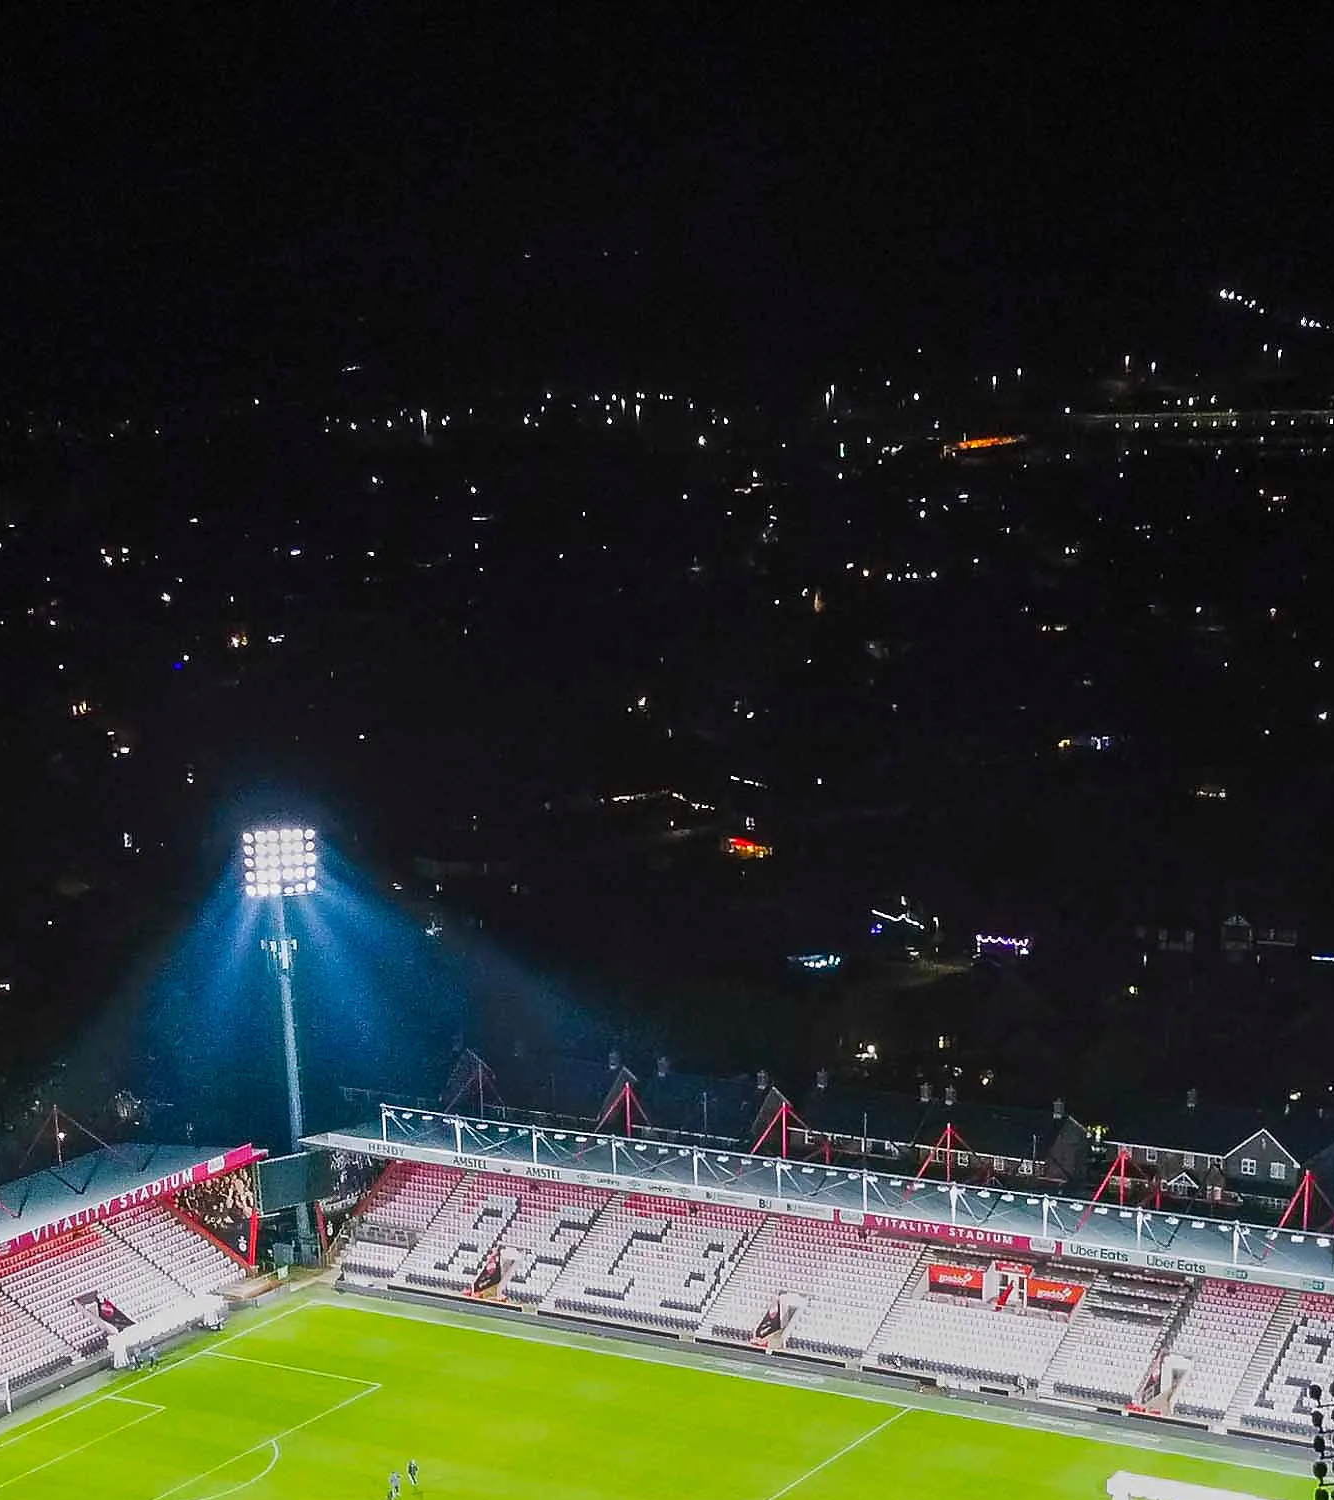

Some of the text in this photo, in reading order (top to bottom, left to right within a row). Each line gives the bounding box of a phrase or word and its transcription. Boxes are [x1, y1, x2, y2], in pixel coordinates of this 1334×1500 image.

[367, 1143, 405, 1157] HENDY
[452, 1156, 489, 1170] AMSTEL
[525, 1166, 562, 1180] AMSTEL
[30, 1166, 194, 1243] VITALITY STADIUM
[874, 1216, 940, 1235] VITALITY
[947, 1222, 1015, 1245] STADIUM
[1069, 1243, 1099, 1258] Uber
[1099, 1248, 1129, 1263] Eats
[1146, 1254, 1175, 1270] Uber
[1176, 1260, 1207, 1274] Eats
